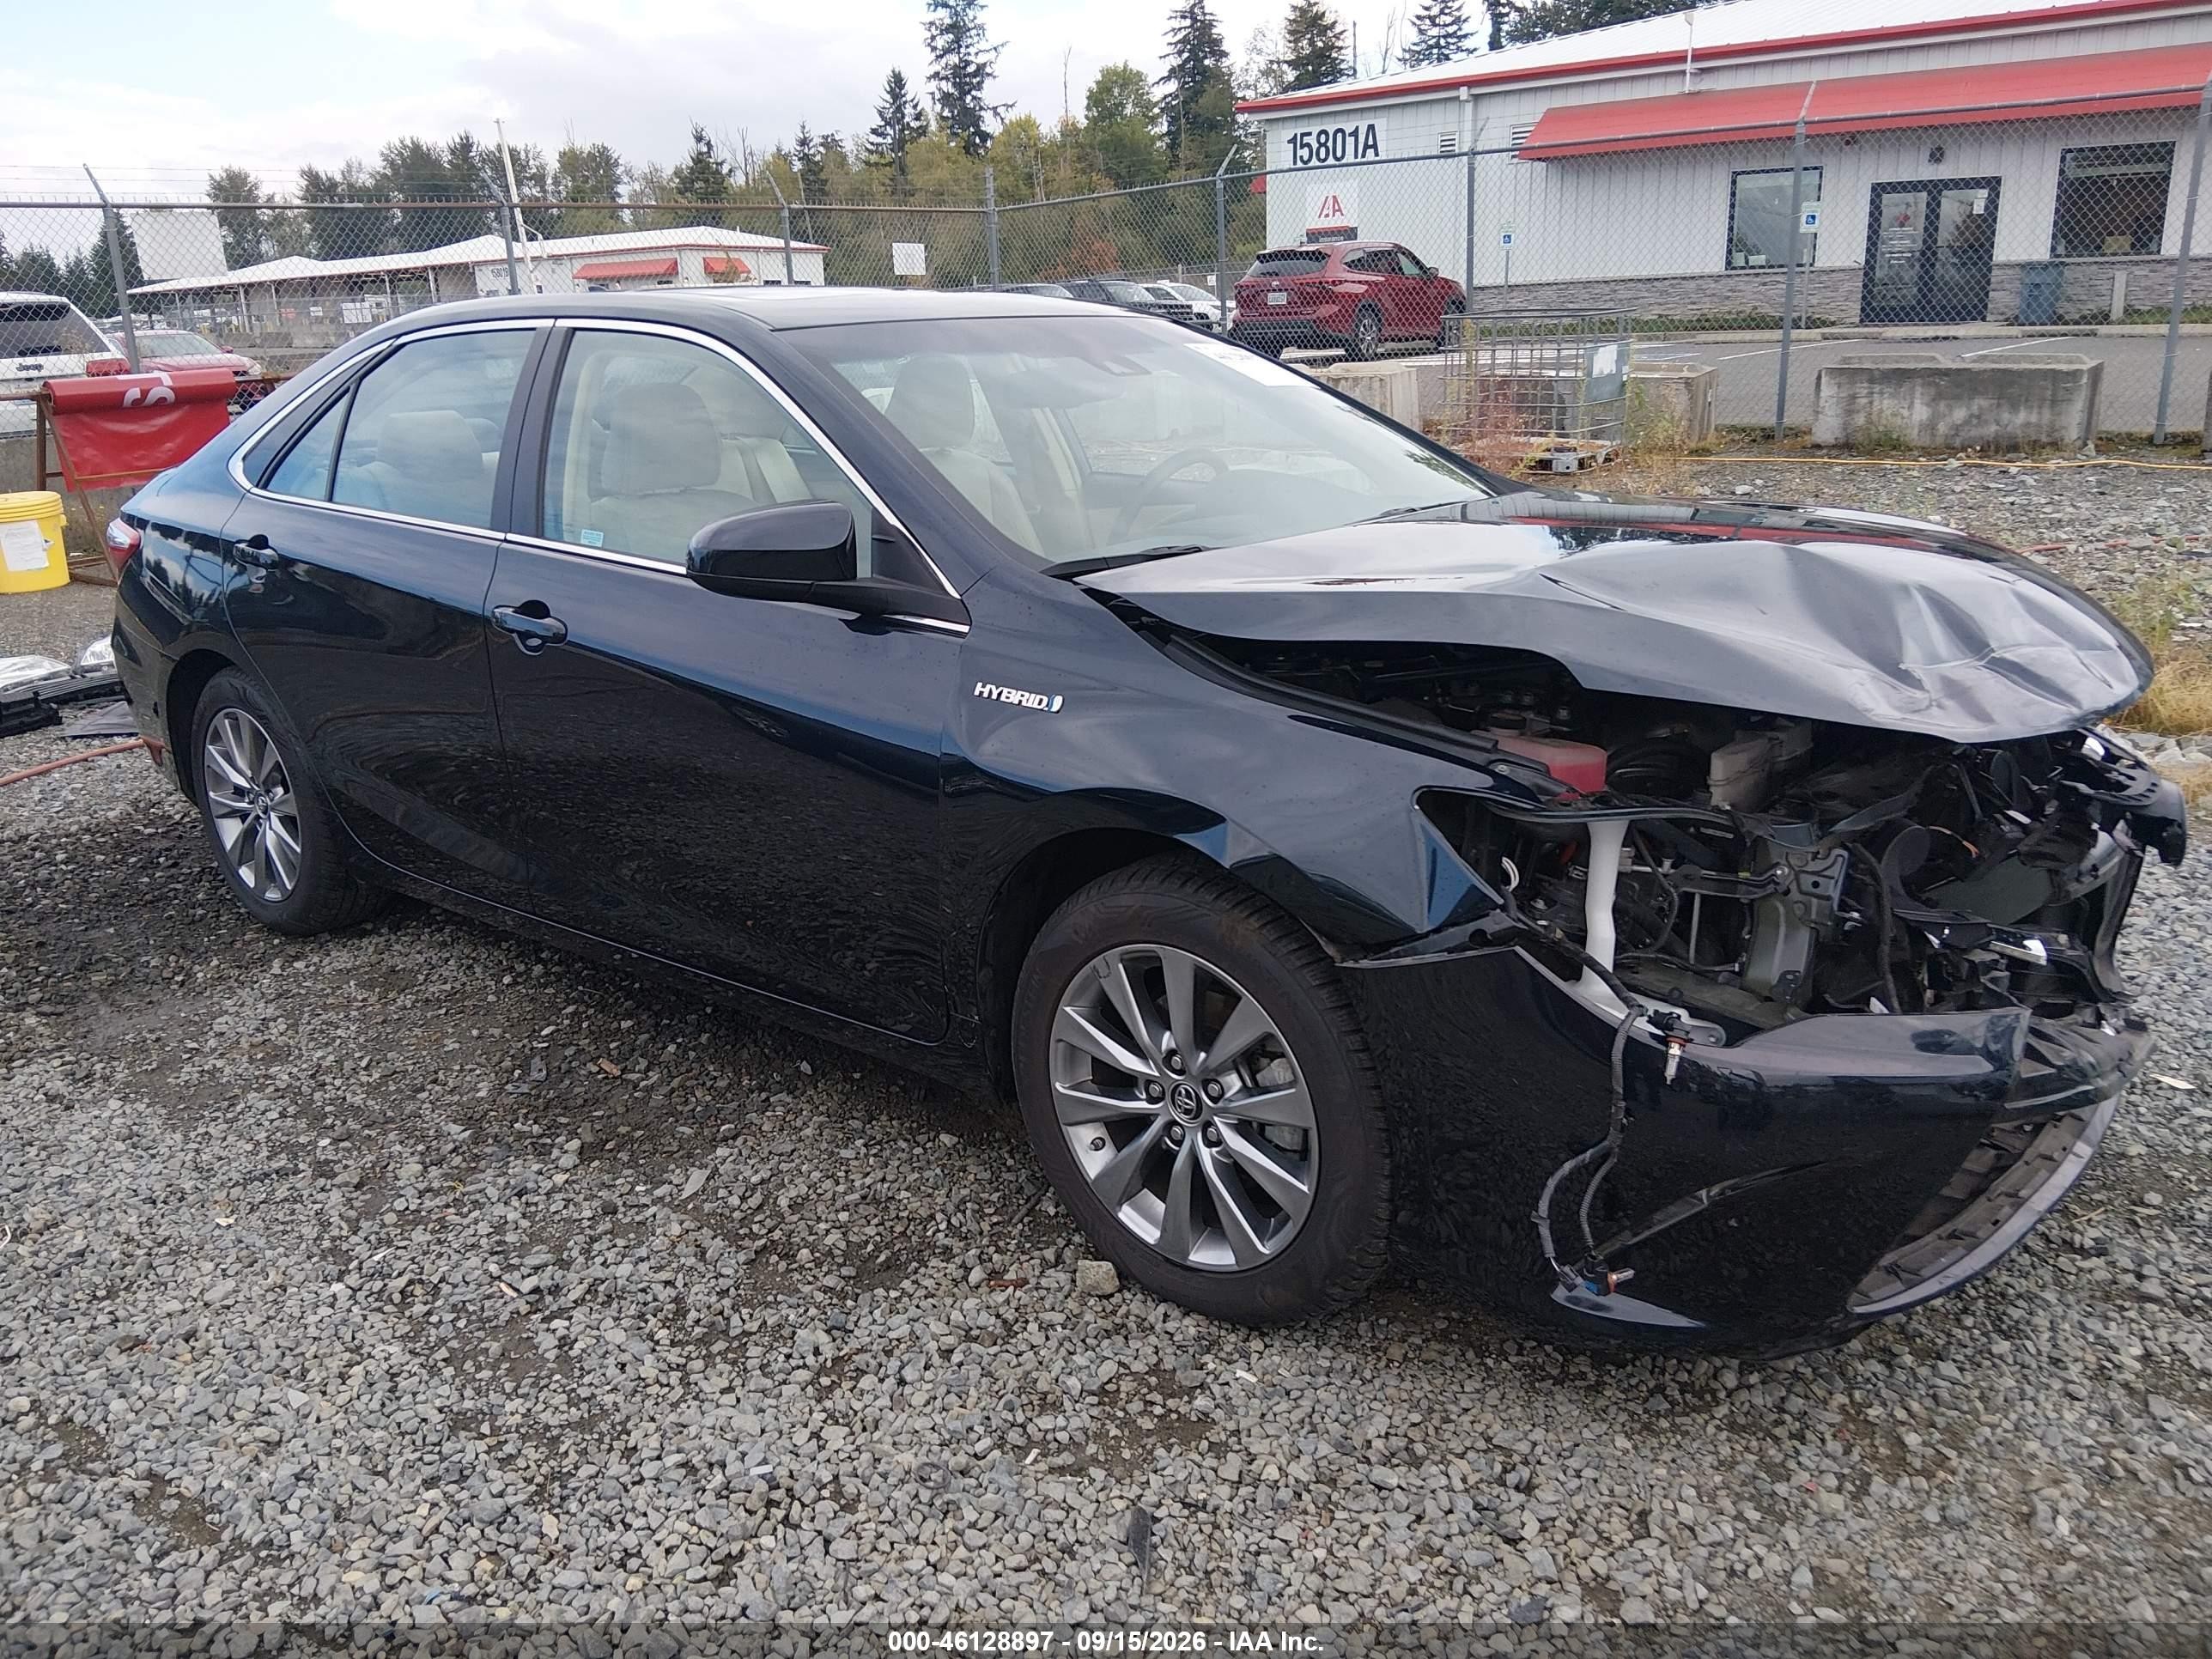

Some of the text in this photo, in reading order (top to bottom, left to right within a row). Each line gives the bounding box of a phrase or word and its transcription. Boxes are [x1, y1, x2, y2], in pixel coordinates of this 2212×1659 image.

[1286, 123, 1380, 166] 15801A
[15, 362, 44, 373] Jeep
[973, 681, 1049, 711] HYBRID
